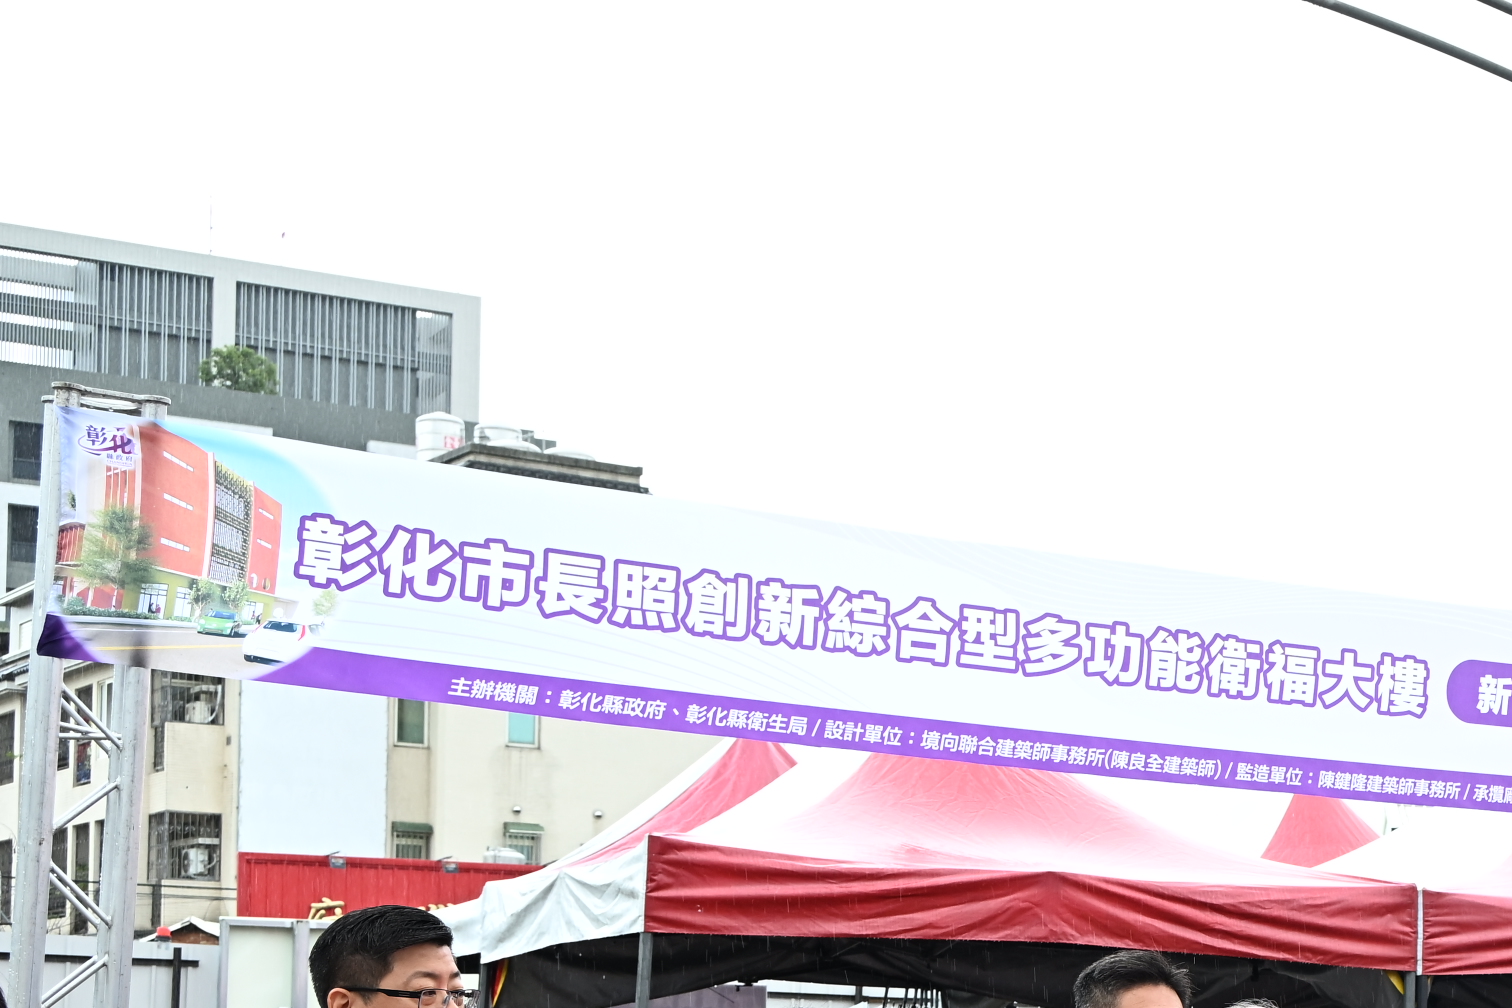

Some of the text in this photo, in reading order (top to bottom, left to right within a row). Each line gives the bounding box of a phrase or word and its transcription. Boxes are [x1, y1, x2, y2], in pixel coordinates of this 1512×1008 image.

[294, 512, 1430, 720] 彰化市長照創新綜合型多功能衛福大樓
